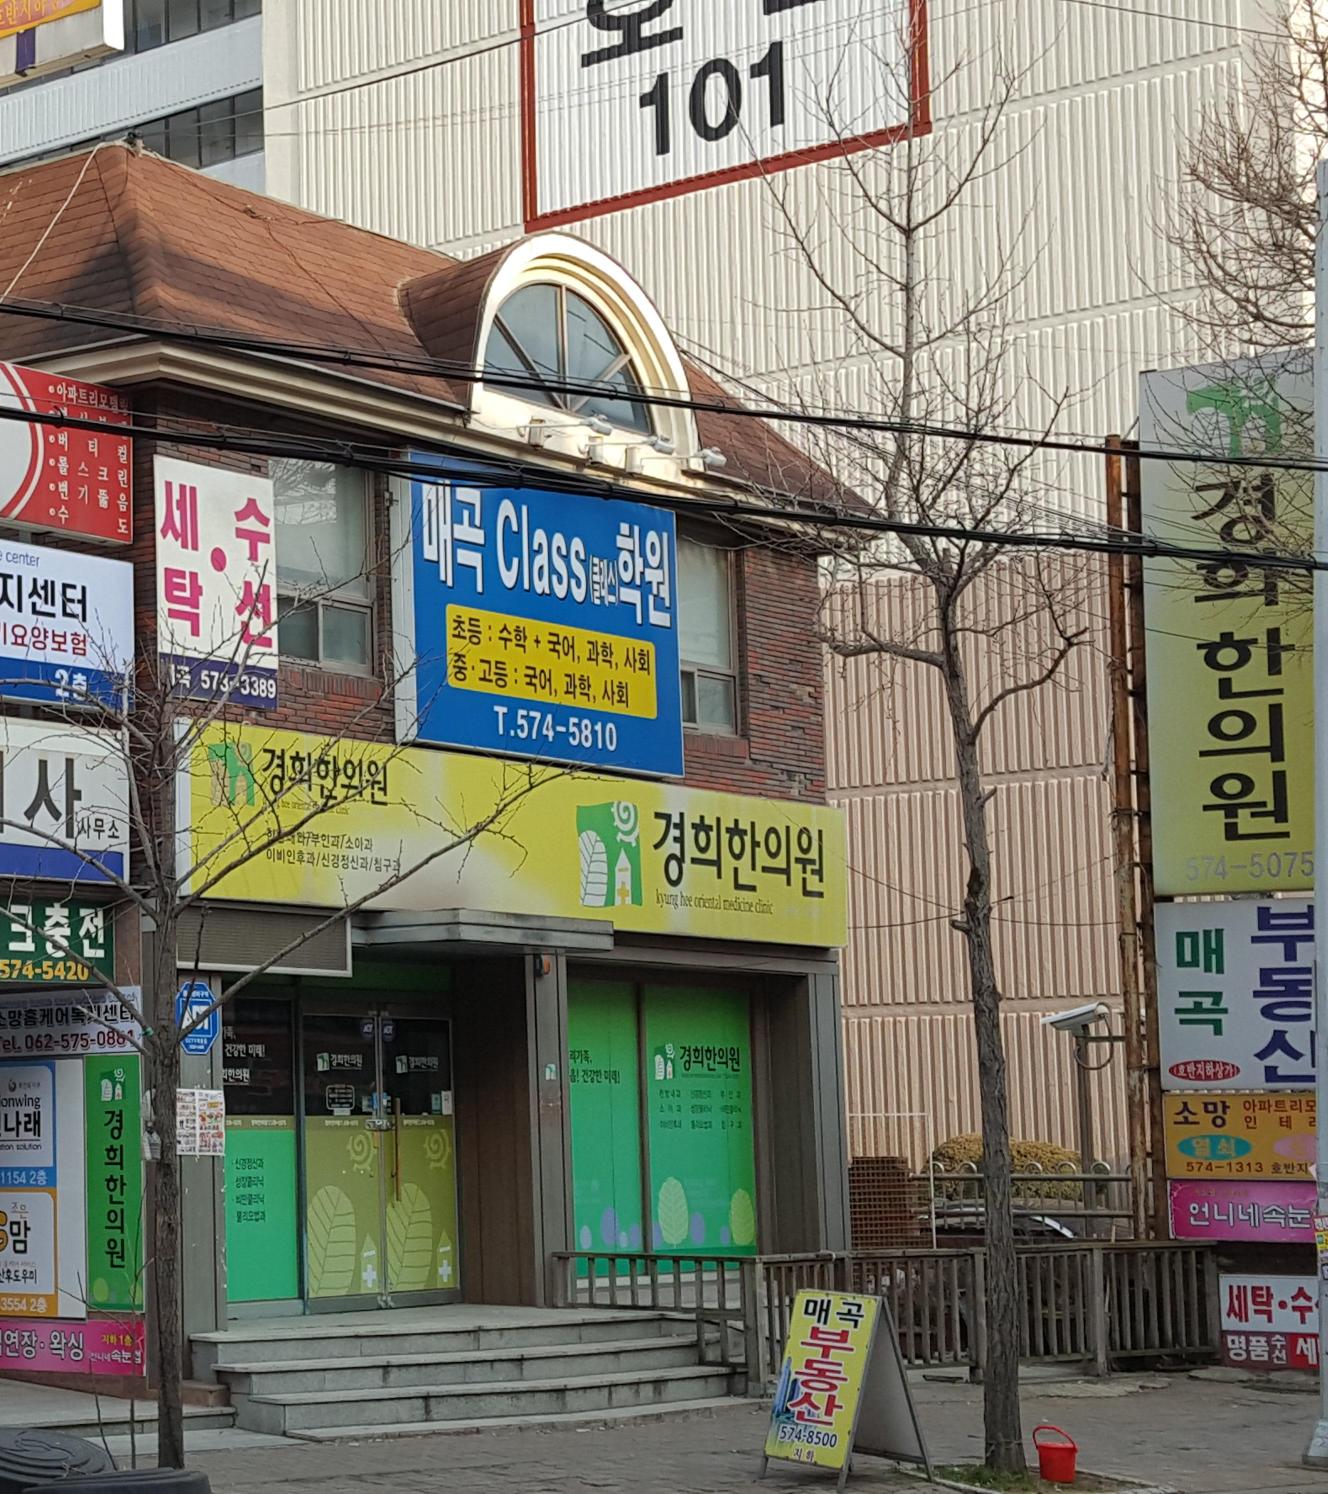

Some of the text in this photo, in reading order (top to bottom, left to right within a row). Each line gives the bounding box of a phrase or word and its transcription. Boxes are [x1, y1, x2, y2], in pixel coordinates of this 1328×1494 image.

[639, 41, 784, 156] 101
[422, 479, 486, 594] 매곡
[7, 545, 41, 568] center
[498, 622, 529, 655] 수학
[623, 645, 652, 677] 사회
[1190, 473, 1297, 841] 경희한의원
[601, 680, 630, 709] 사회
[492, 704, 618, 752] T.574-5810
[261, 746, 390, 806] 경희한의원
[652, 810, 825, 899] 경희한의원
[1184, 849, 1315, 884] 574-5075
[0, 958, 90, 983] 574-5420
[1174, 927, 1230, 1037] 매곡
[679, 1045, 741, 1073] 경희한의원
[1173, 1100, 1231, 1129] 소망
[29, 1170, 48, 1186] 2층
[1186, 1161, 1264, 1174] 574-1313
[103, 1110, 128, 1269] 경희한의원
[1188, 1202, 1312, 1229] 언니네속눈
[9, 1219, 31, 1255] 맘
[803, 1298, 865, 1330] 매곡
[1226, 1335, 1270, 1362] 명품
[787, 1325, 856, 1428] 부동산
[778, 1425, 838, 1449] 574-8500
